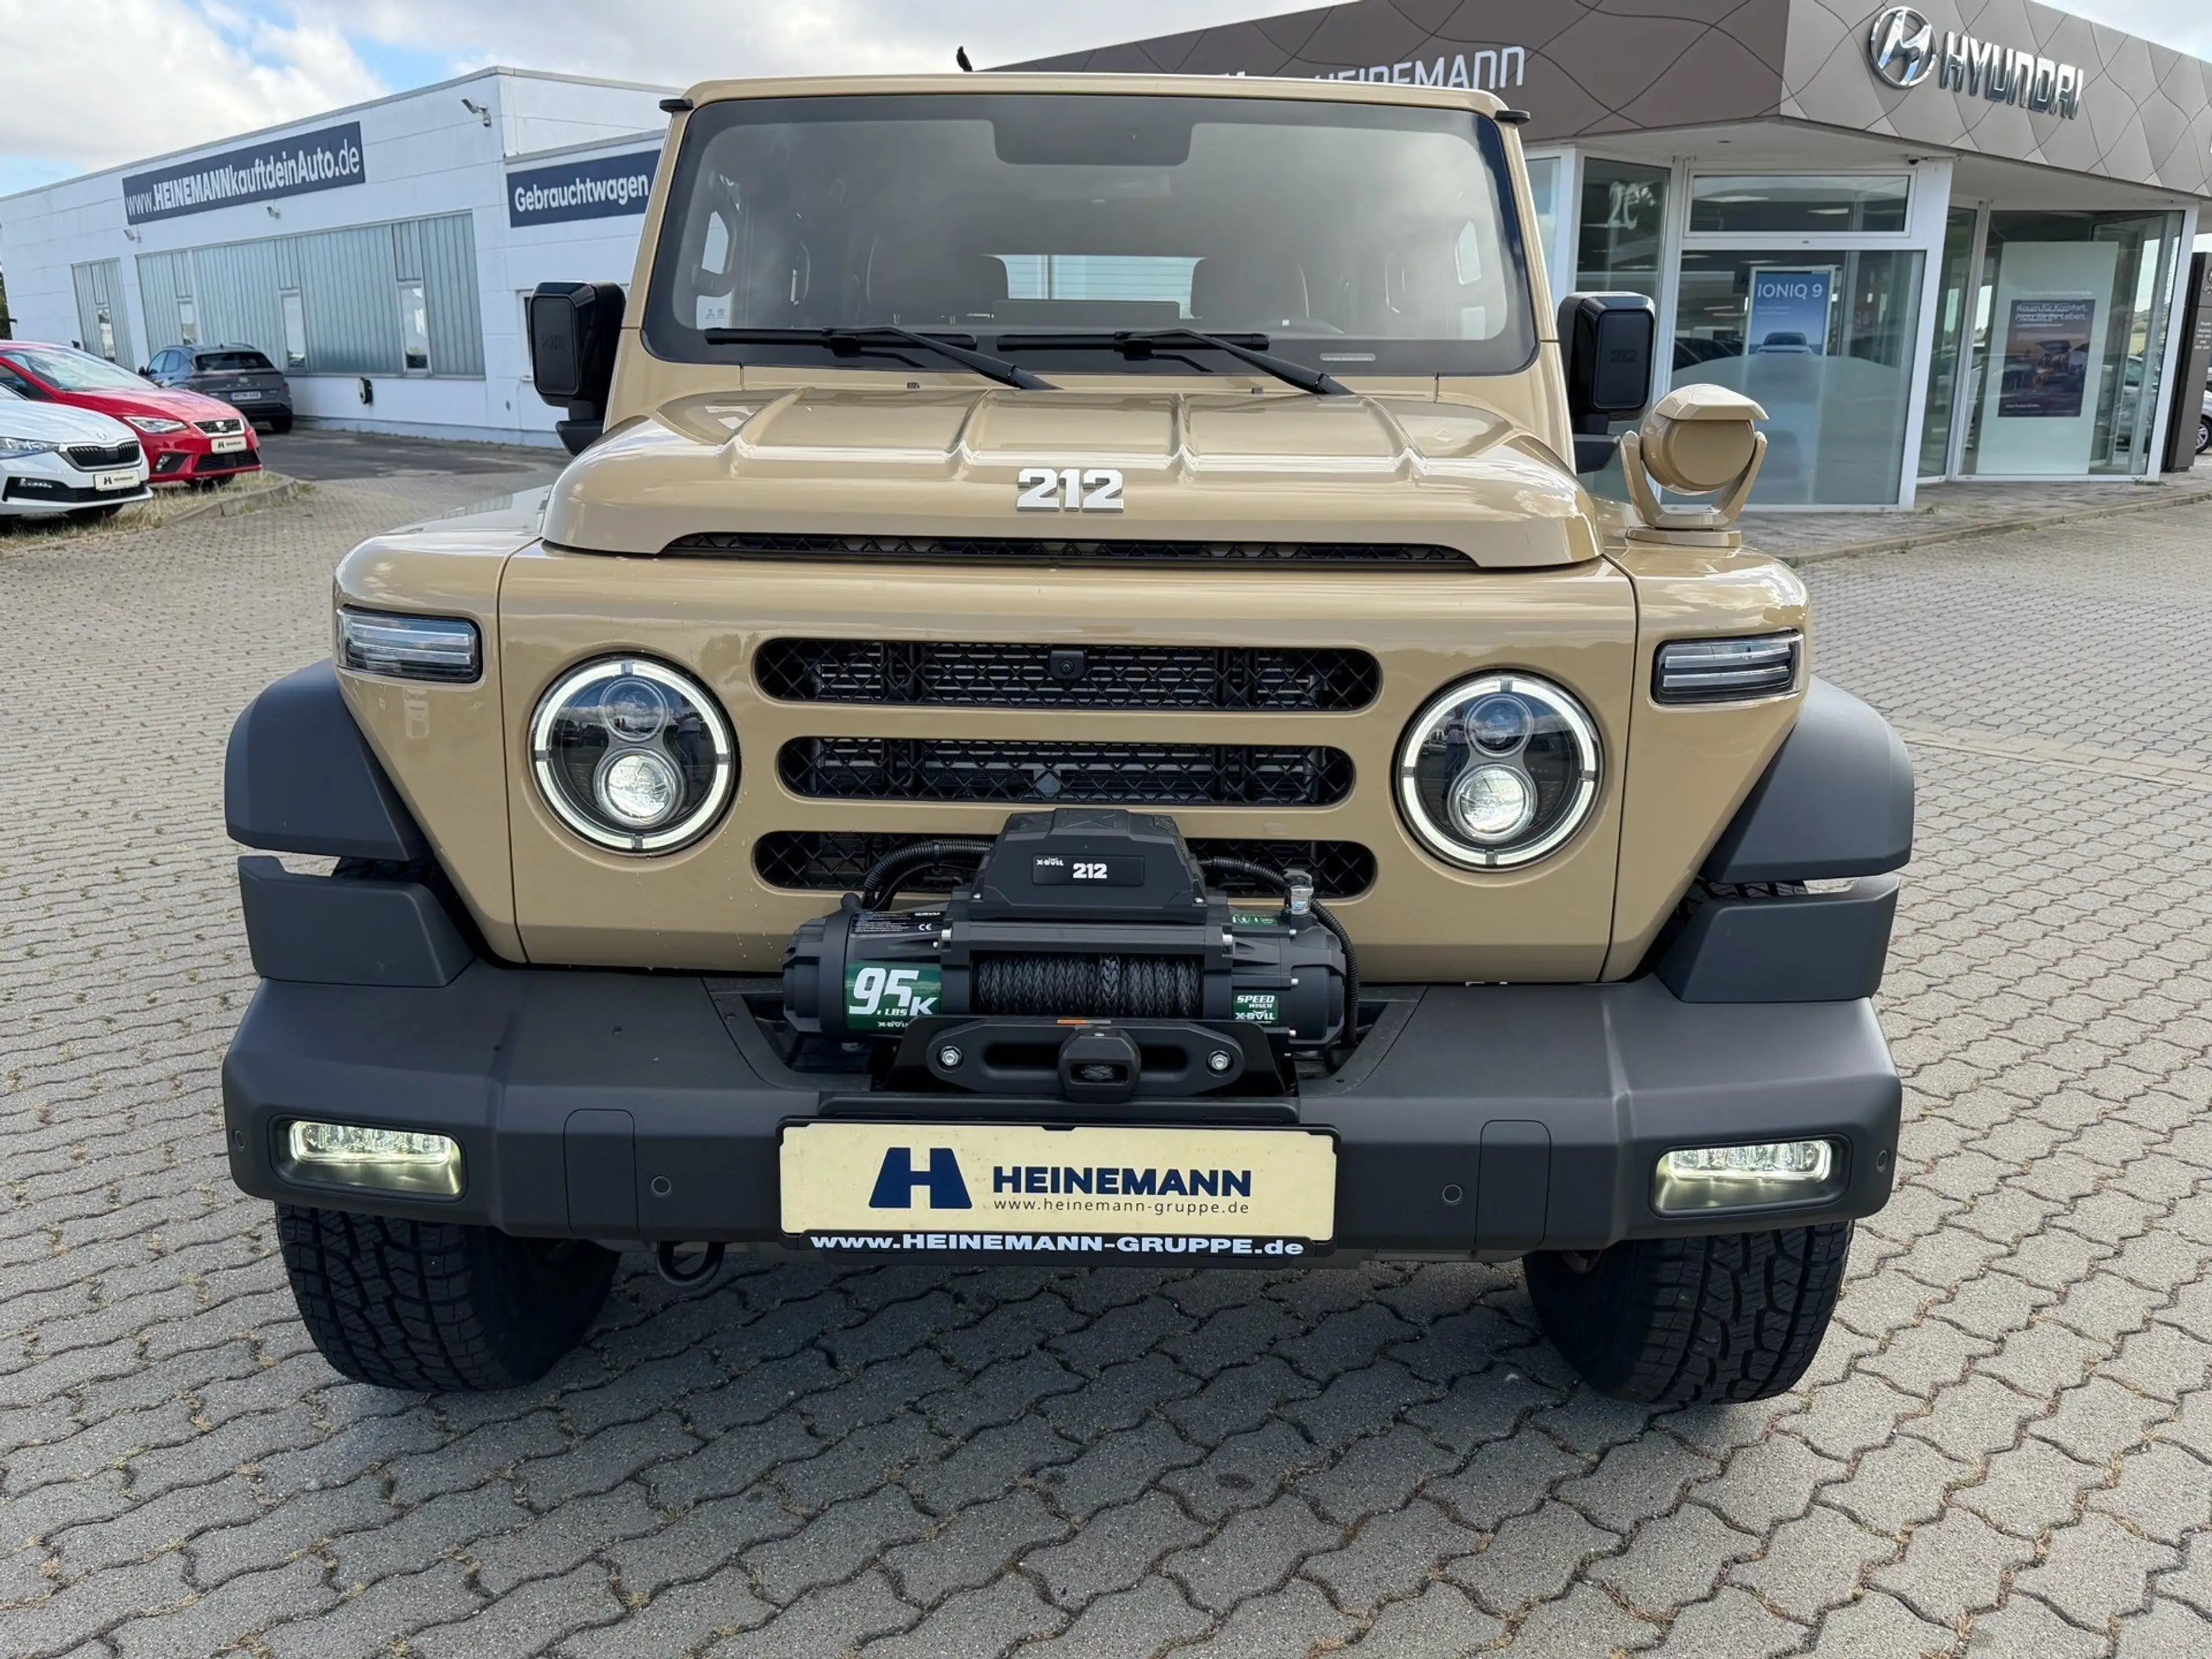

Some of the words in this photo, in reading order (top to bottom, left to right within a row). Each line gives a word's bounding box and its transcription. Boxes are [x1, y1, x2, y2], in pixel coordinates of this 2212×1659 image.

[1315, 46, 1525, 89] EMANN
[1940, 32, 2084, 120] HYUNDAI
[125, 139, 359, 216] www.HEINEMANNkauftdeinAuto.de
[514, 175, 649, 211] Gebrauchtwagen
[1758, 283, 1808, 300] IONIQ
[1812, 283, 1823, 298] 9
[1610, 349, 1638, 363] 212
[1017, 468, 1124, 513] 212
[1073, 863, 1108, 879] 212
[1236, 995, 1275, 1003] SPEED
[884, 1008, 908, 1016] LBS
[993, 1165, 1251, 1197] HEINEMANN
[993, 1198, 1249, 1215] www.heinemann-gruppe.de
[810, 1233, 1304, 1256] www.HEINEMANN-GRUPPE.de
